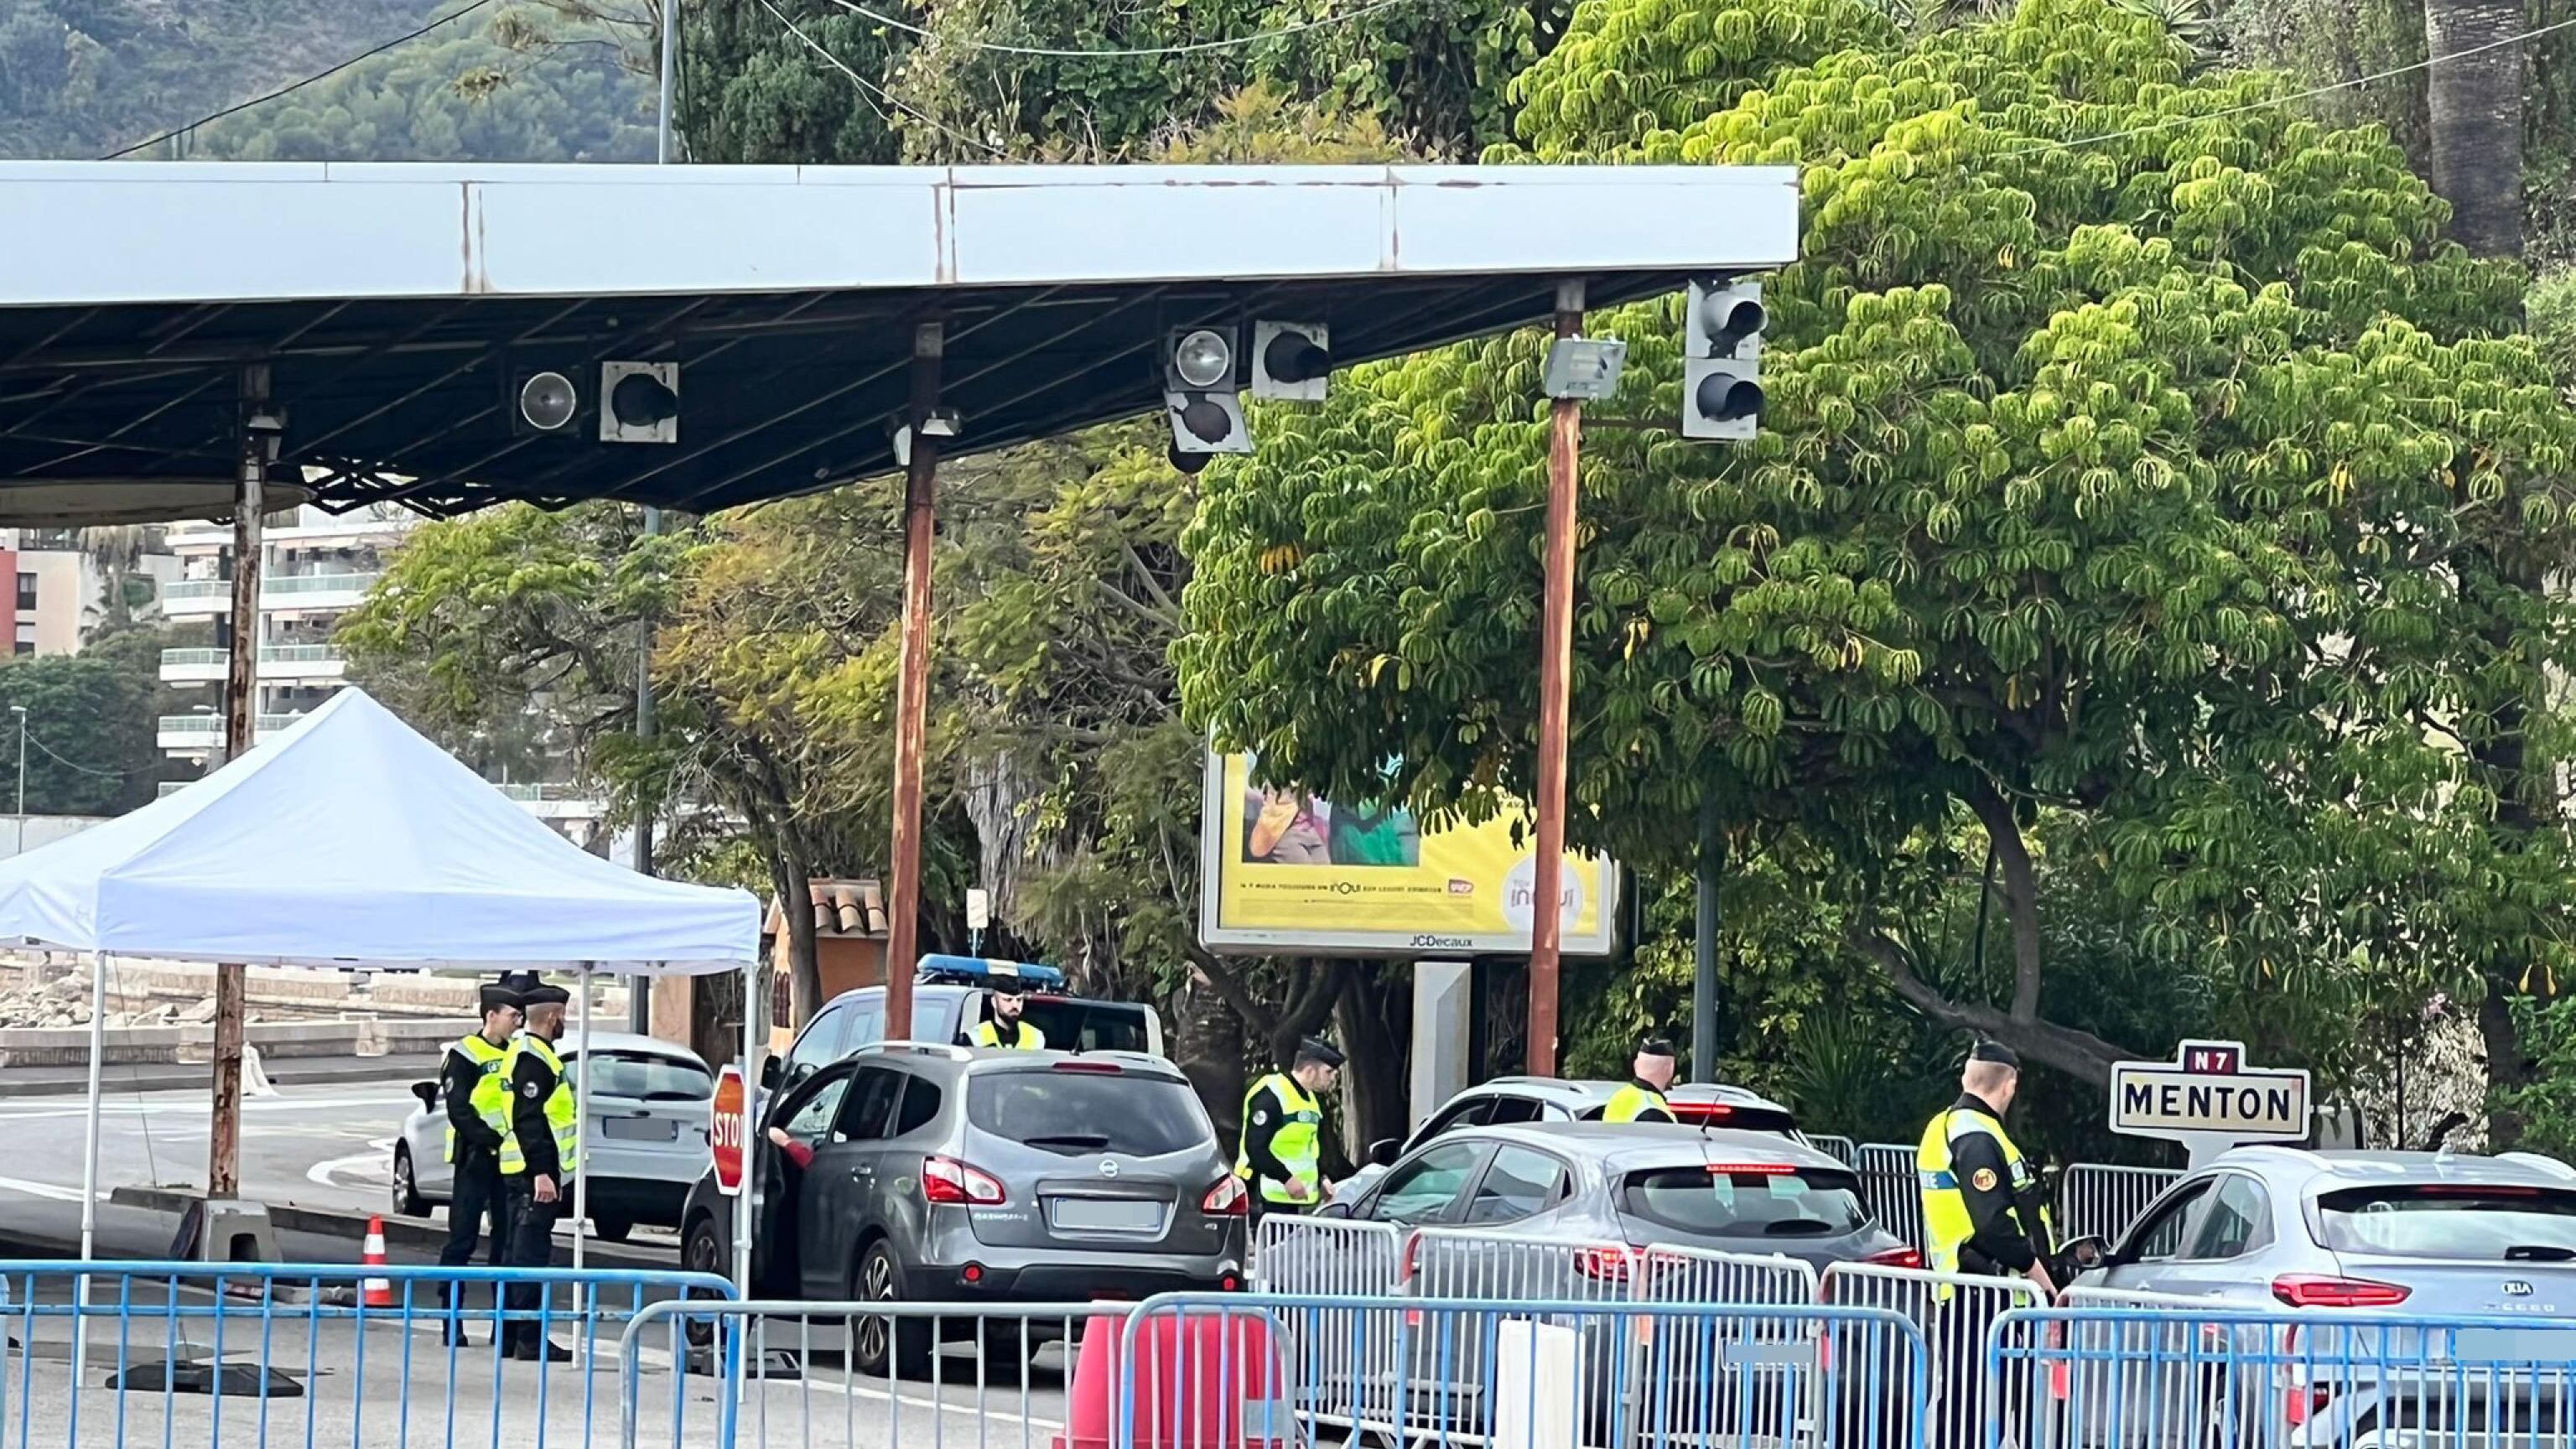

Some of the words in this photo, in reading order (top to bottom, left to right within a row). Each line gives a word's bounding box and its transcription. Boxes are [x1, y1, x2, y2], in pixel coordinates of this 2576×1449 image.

[1410, 934, 1472, 947] JCDecaux
[2194, 1052, 2209, 1070] N
[2215, 1052, 2228, 1070] 7
[2125, 1083, 2290, 1121] MENTON
[2506, 1282, 2532, 1293] KIA
